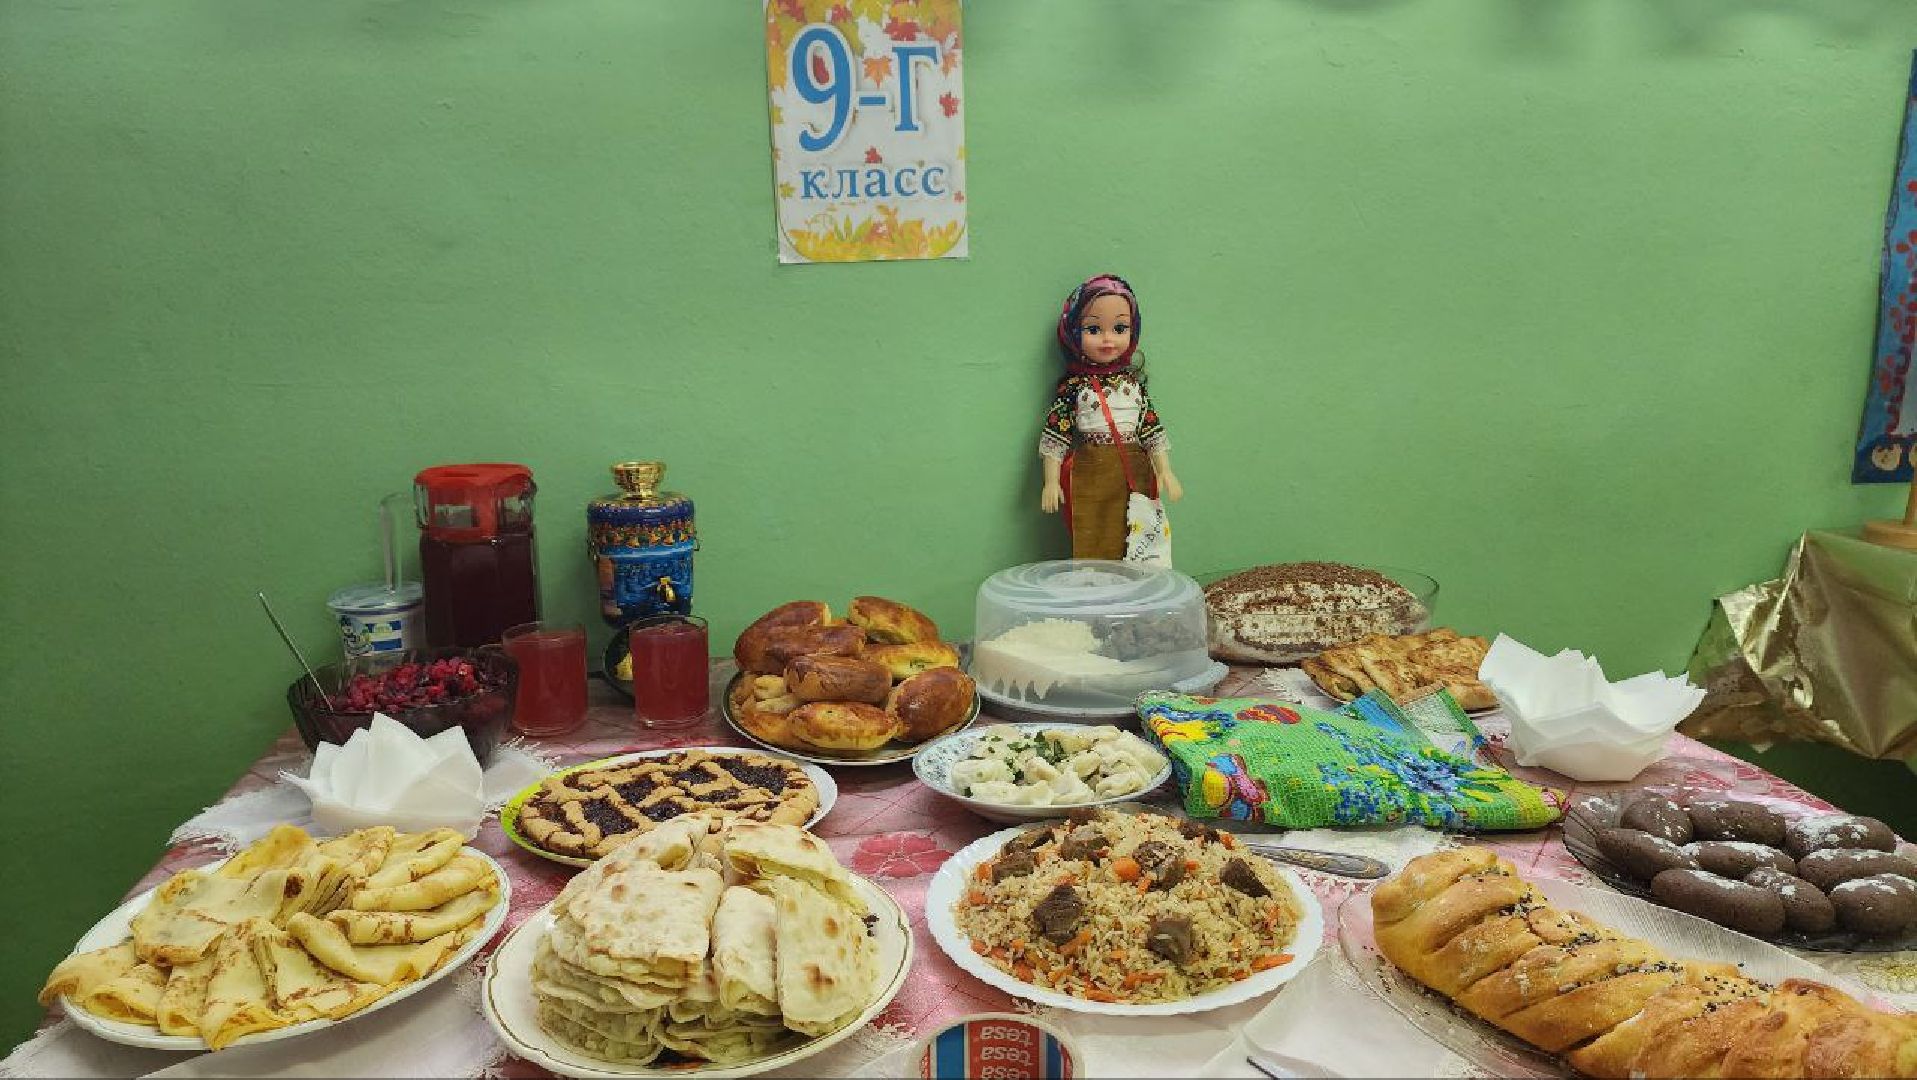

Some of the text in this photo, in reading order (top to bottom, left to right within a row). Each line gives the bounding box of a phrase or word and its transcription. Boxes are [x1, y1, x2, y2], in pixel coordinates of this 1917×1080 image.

[792, 28, 938, 151] 9-Г
[801, 166, 946, 200] класс
[980, 1026, 1032, 1047] tesa
[981, 1046, 1033, 1067] tesa
